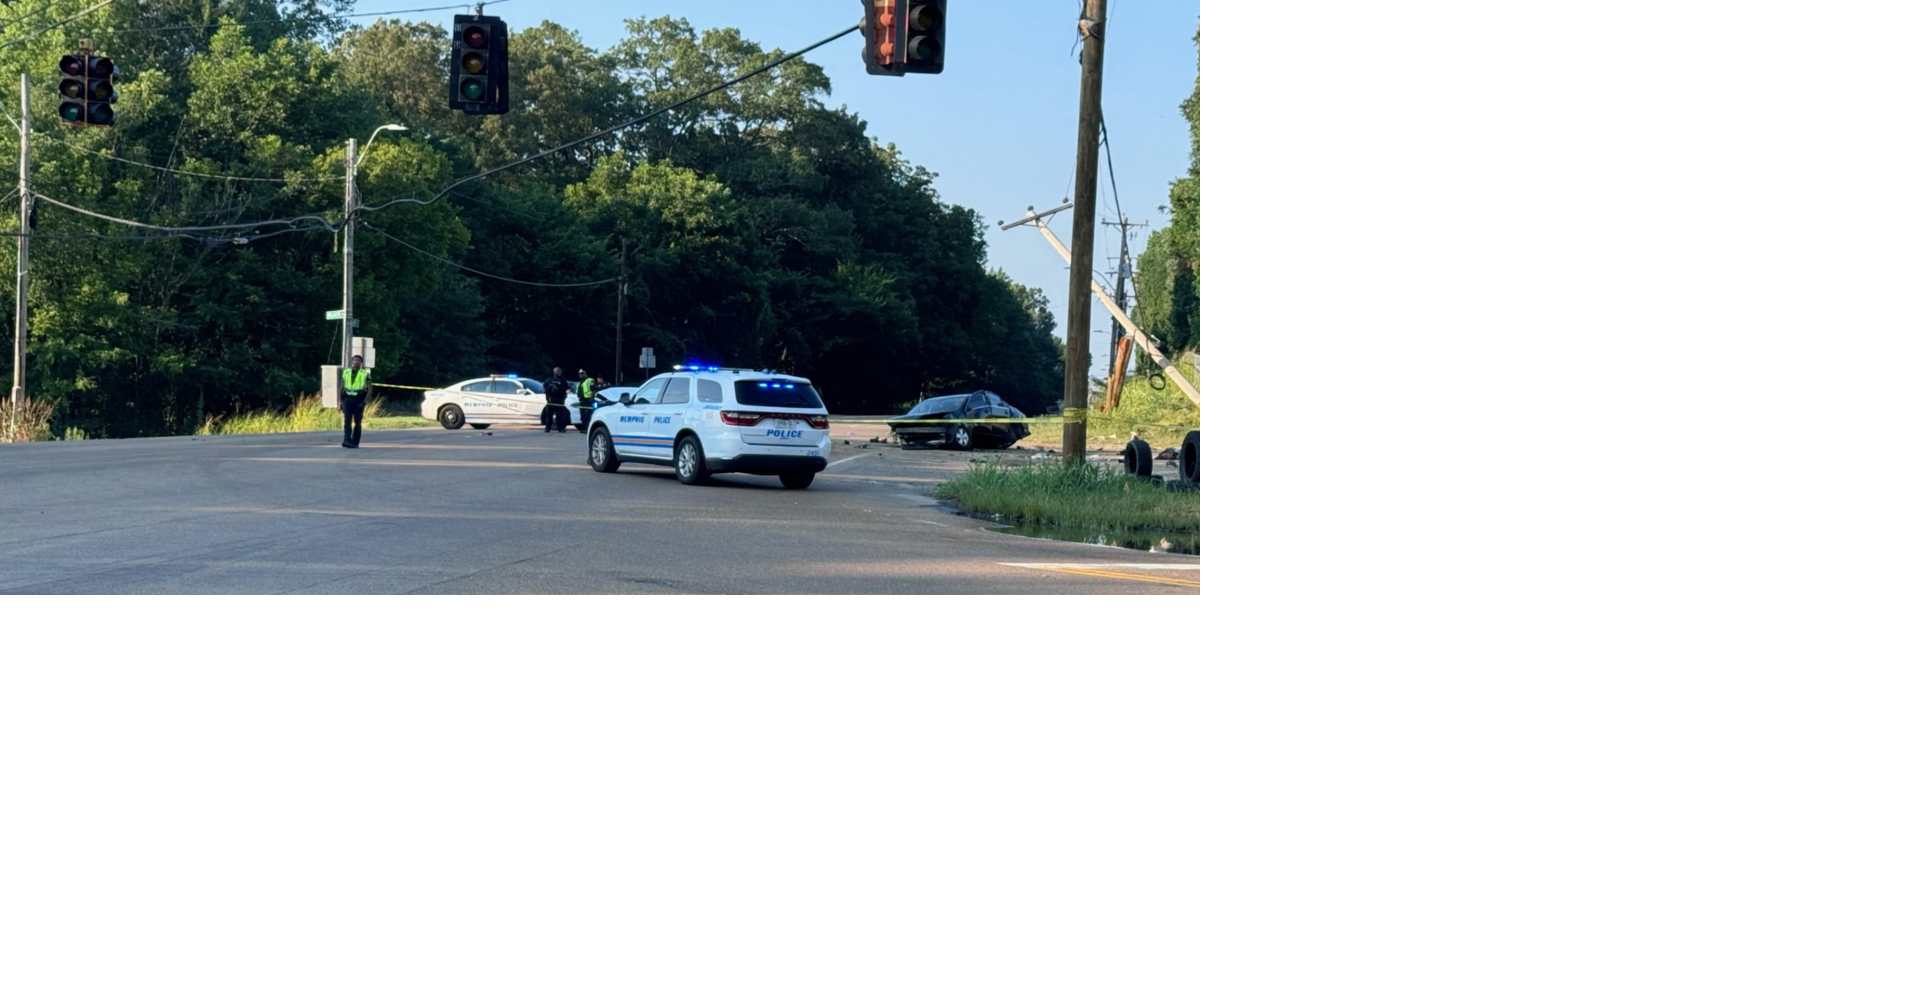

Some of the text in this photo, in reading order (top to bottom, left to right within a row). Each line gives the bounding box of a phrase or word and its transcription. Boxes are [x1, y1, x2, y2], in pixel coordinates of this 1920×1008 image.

[620, 415, 671, 424] MEMPHIS POLICE
[766, 429, 804, 438] POLICE
